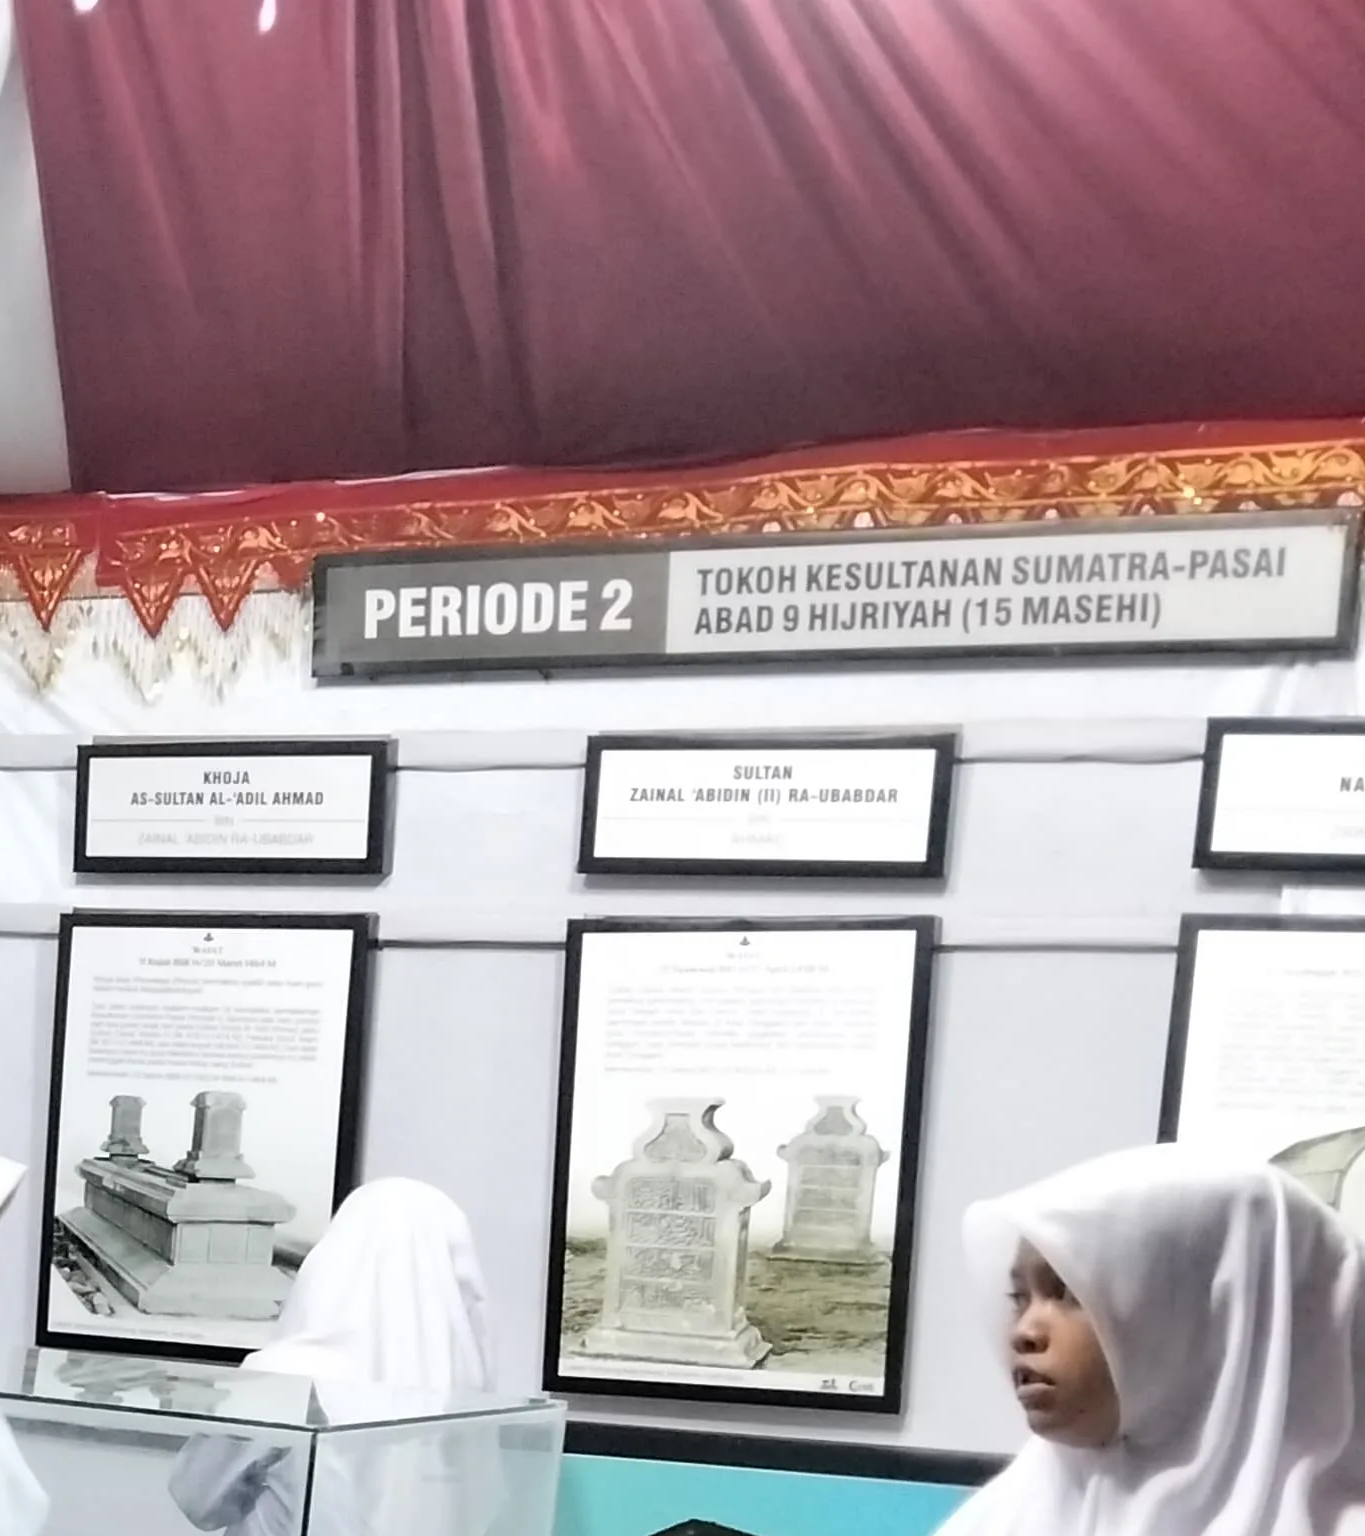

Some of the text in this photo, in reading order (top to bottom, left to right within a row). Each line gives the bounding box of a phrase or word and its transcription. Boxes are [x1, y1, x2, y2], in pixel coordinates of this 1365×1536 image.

[697, 547, 1286, 597] TOKOH KESULTANAN SUMATRA-PASAI
[364, 578, 633, 639] PERIODE 2
[694, 592, 1163, 635] ABAD 9 HIJRIYAH (15 MASEHI)
[204, 771, 250, 784] KHOJA
[733, 766, 793, 780] SULTAN
[131, 792, 204, 805] AS-SULTAN
[272, 792, 324, 805] AHMAD
[630, 788, 685, 802] ZAINAL
[758, 788, 780, 805] (II)
[789, 788, 898, 803] RA-UBABDAR
